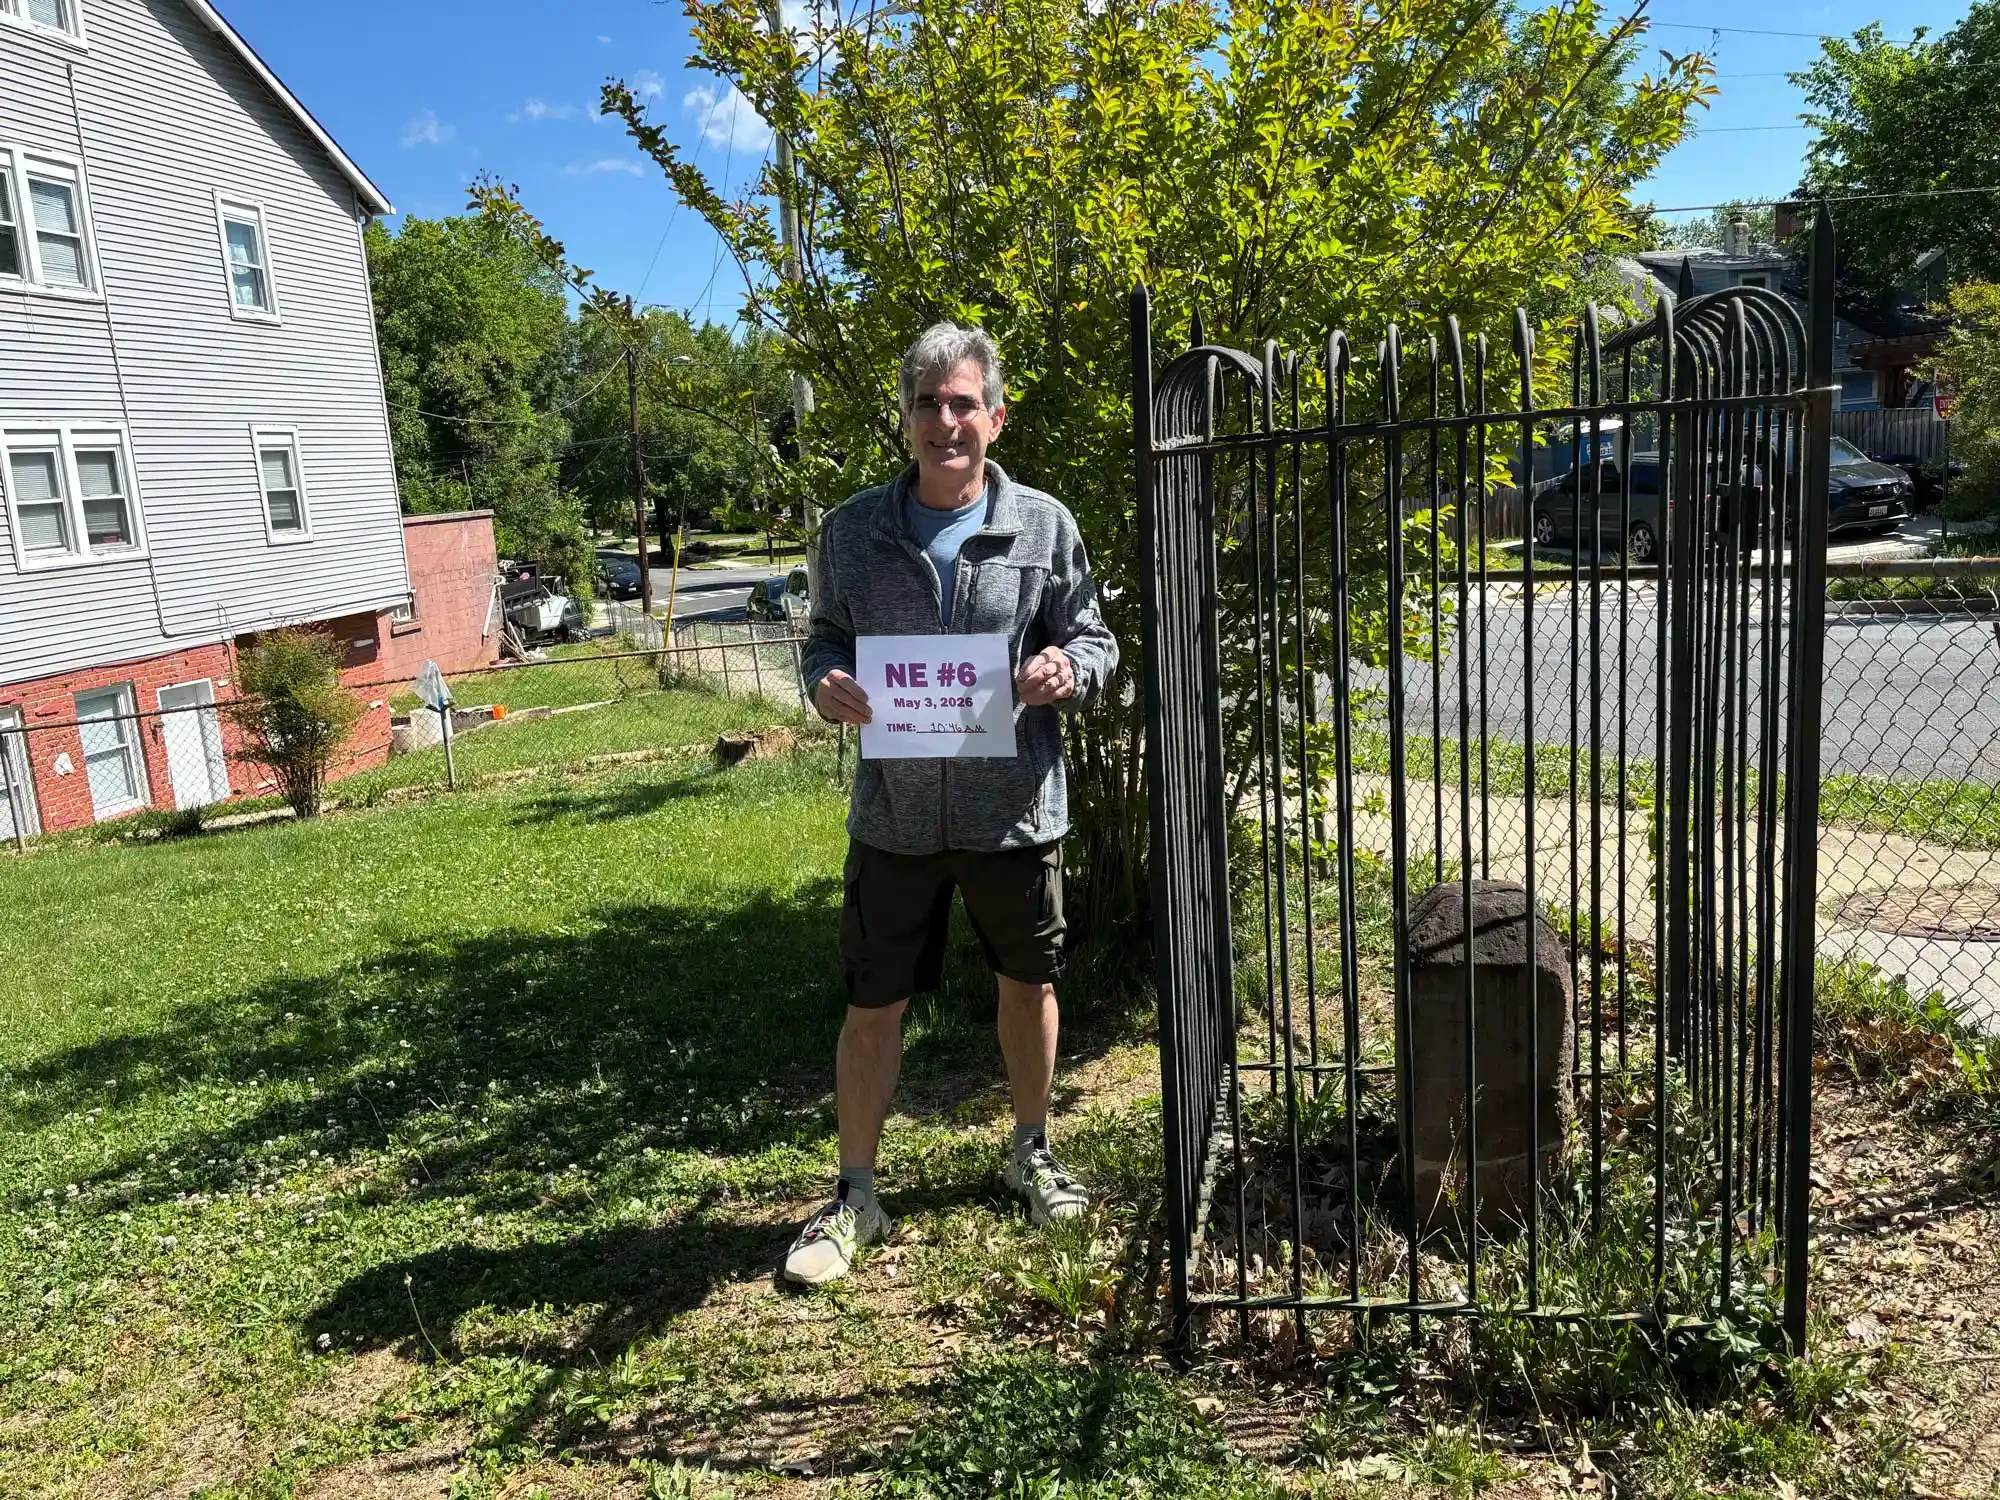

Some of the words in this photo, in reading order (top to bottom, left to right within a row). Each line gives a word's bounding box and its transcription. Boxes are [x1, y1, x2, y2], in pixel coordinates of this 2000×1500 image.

[885, 663, 928, 688] NE
[937, 662, 977, 687] #6
[893, 698, 921, 710] May
[924, 697, 937, 710] 3,
[940, 697, 973, 708] 2026
[886, 723, 916, 732] TIME:
[930, 722, 962, 733] 10:46
